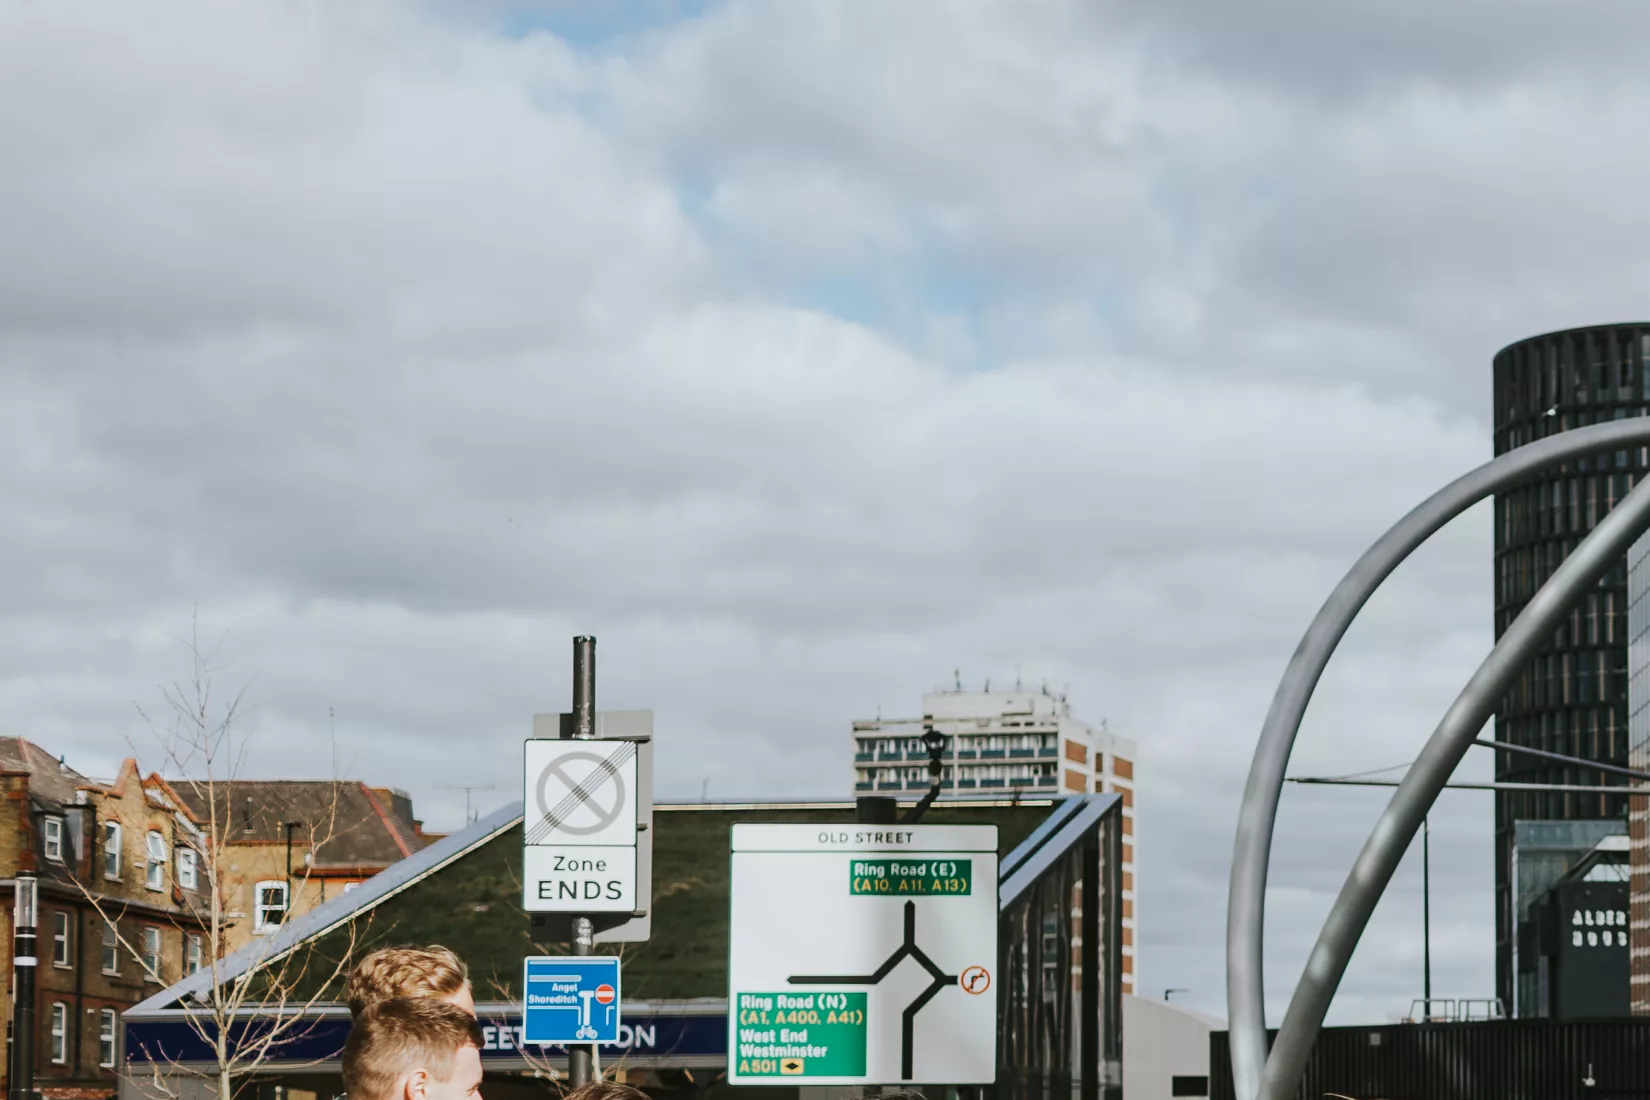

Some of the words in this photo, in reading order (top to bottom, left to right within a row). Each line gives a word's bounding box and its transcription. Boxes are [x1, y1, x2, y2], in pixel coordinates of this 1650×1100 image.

[817, 831, 849, 844] OLD
[855, 831, 914, 845] STREET
[552, 855, 607, 872] Zone
[854, 862, 885, 878] Ring
[890, 862, 927, 876] Road
[931, 861, 957, 878] (E)
[537, 879, 623, 900] ENDS
[932, 877, 968, 893] A13)
[551, 982, 578, 994] Angel
[528, 994, 578, 1005] Shoreditch
[740, 993, 773, 1011] Ring
[777, 993, 813, 1008] Road
[817, 993, 848, 1010] (N)
[826, 1010, 864, 1026] A41)
[739, 1028, 776, 1043] West
[780, 1028, 808, 1043] End
[739, 1043, 828, 1058] Westminster
[739, 1059, 777, 1074] A501
